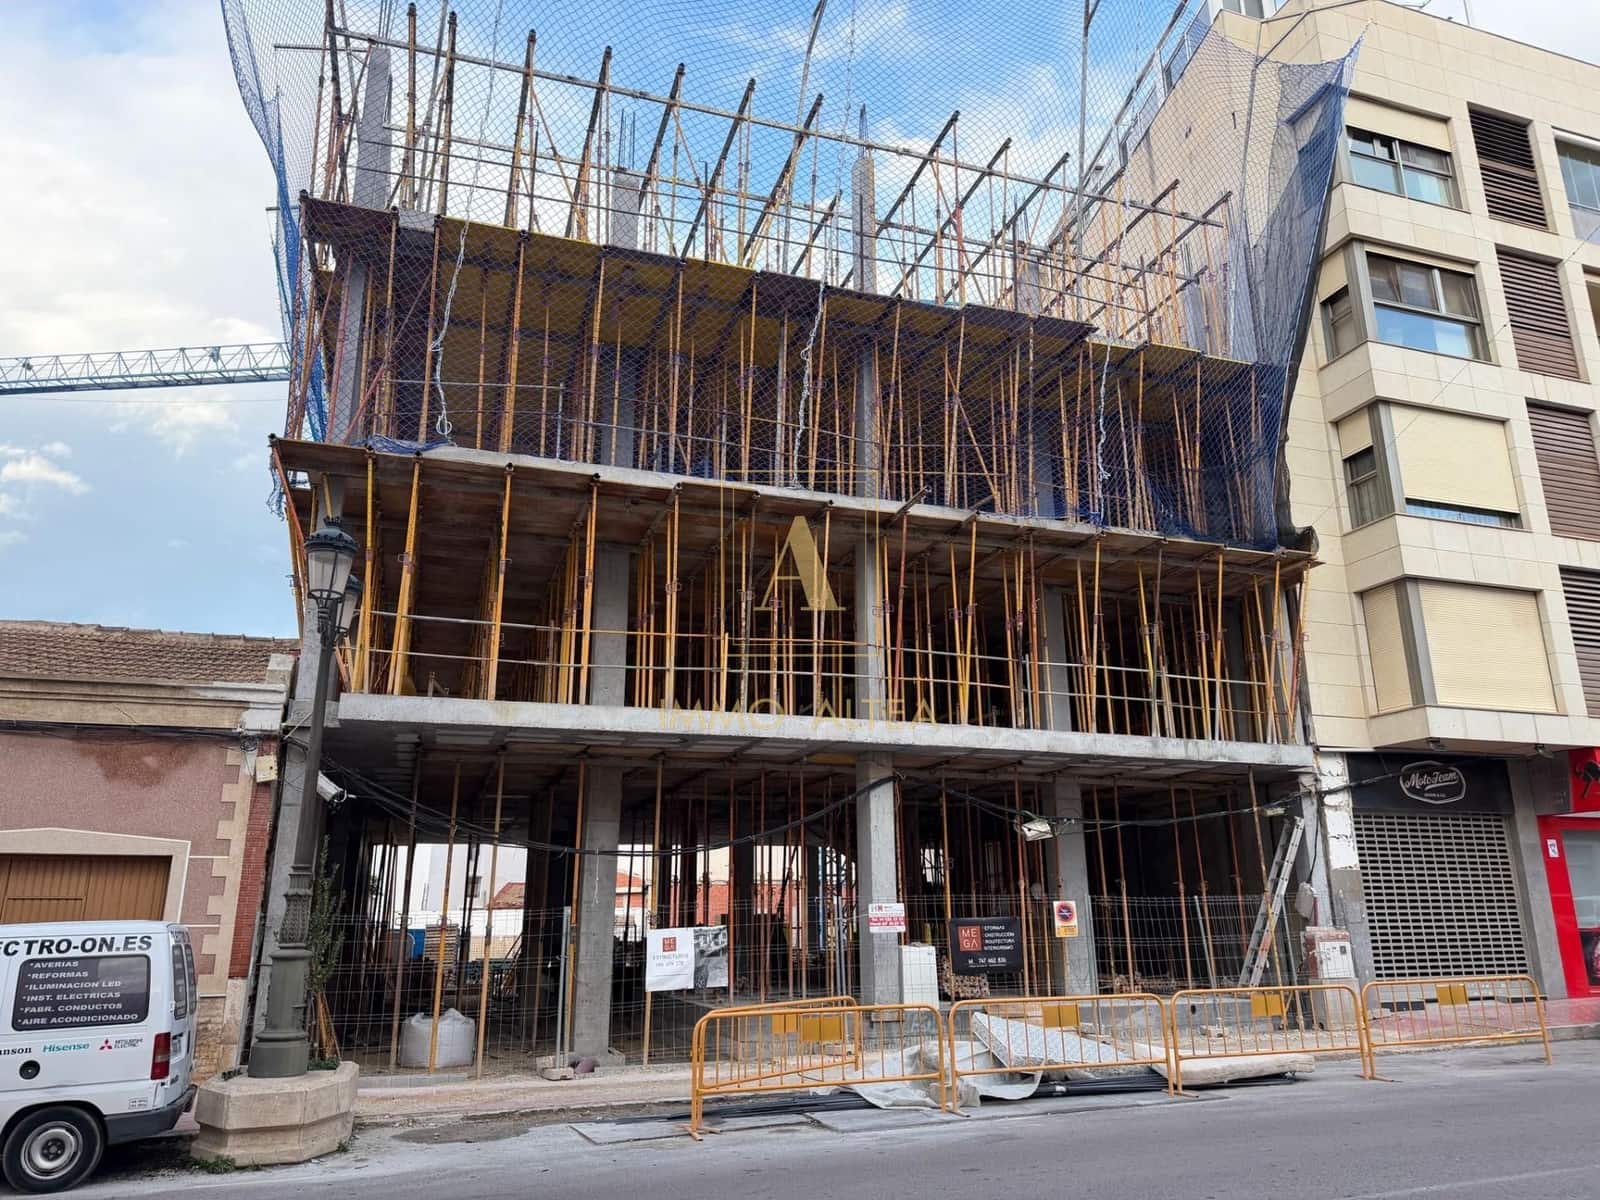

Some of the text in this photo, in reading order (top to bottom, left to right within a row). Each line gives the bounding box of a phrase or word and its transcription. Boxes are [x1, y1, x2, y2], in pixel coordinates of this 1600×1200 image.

[962, 928, 977, 938] ME
[0, 935, 152, 957] CTRO-ON.ES
[101, 980, 121, 988] LED
[26, 992, 121, 1002] INST. ELECTRICAS
[57, 1003, 123, 1012] CONDUCTOS
[21, 1014, 139, 1026] AIRE ACONDICIONADO
[42, 1042, 90, 1053] Hisense
